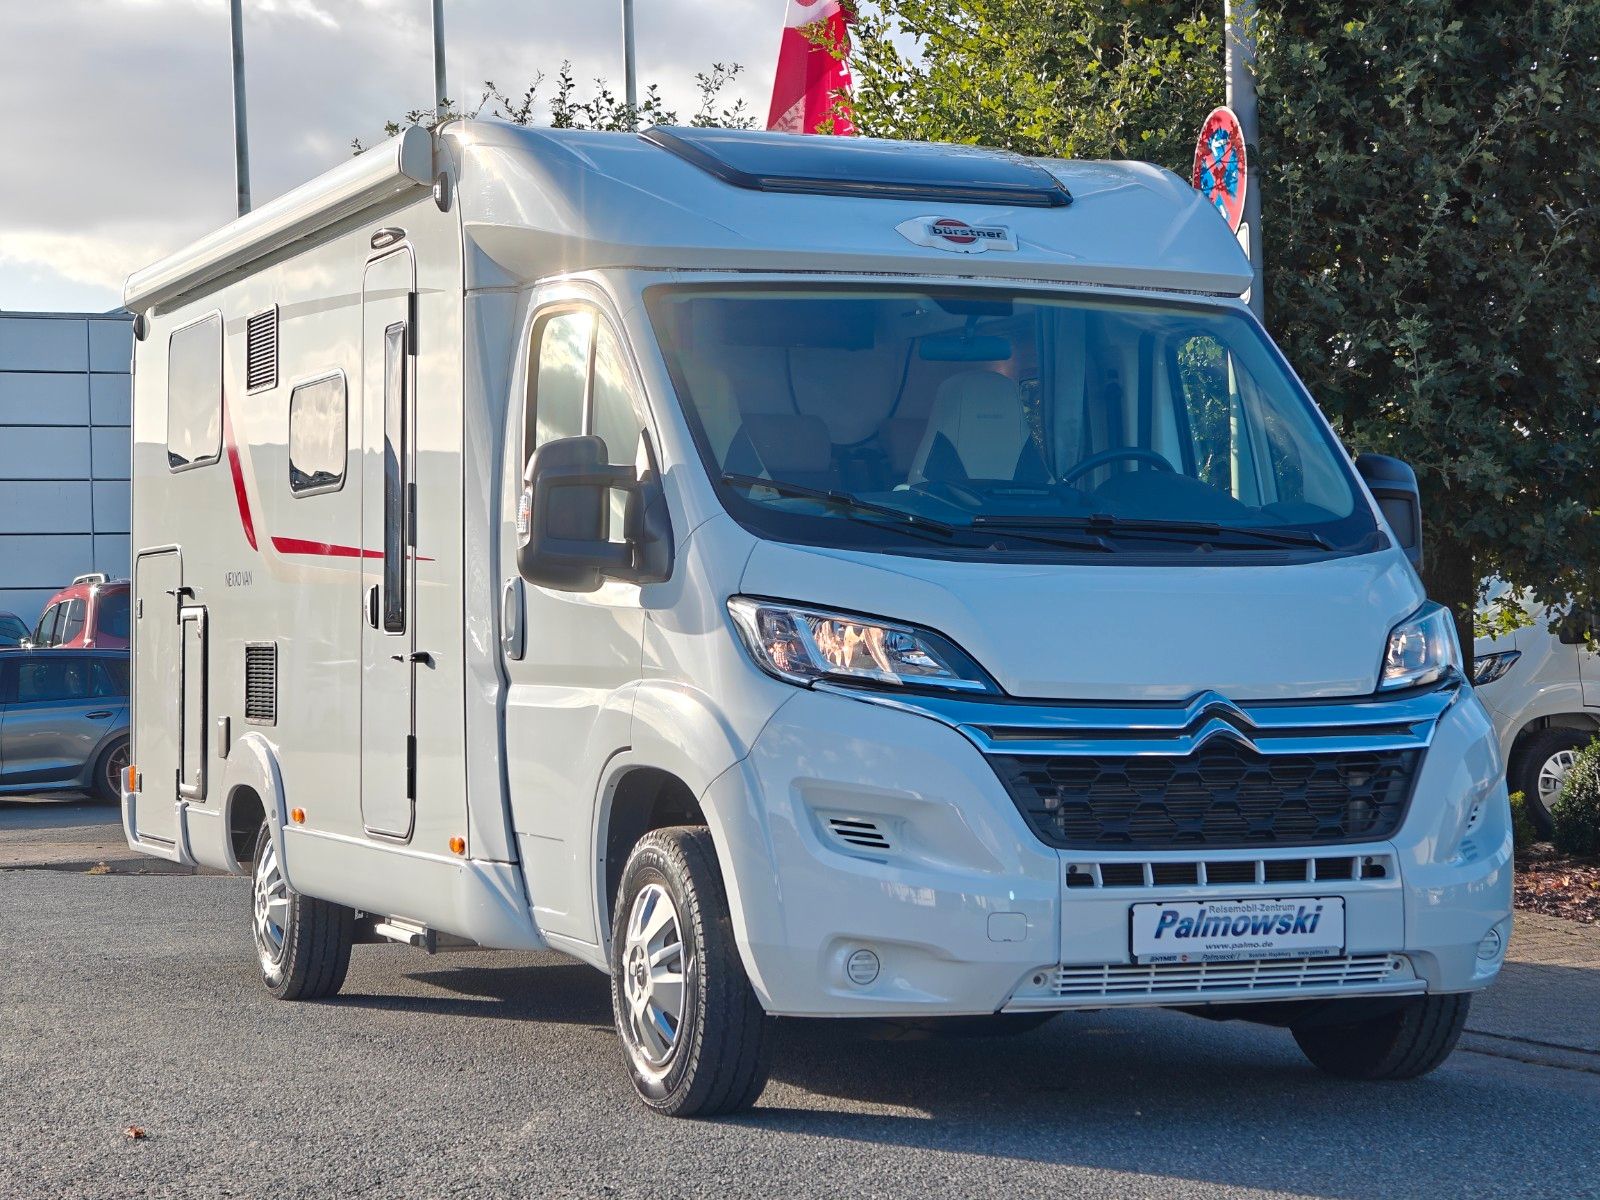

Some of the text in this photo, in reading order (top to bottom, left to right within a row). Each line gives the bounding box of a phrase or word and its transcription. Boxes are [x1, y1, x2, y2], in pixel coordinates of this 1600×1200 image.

[932, 226, 1003, 239] bürstner
[242, 571, 253, 586] VAN
[1209, 904, 1295, 914] Reisemobil-Zentrum
[1154, 905, 1323, 939] Palmowski
[1205, 941, 1274, 950] www.palmo.de
